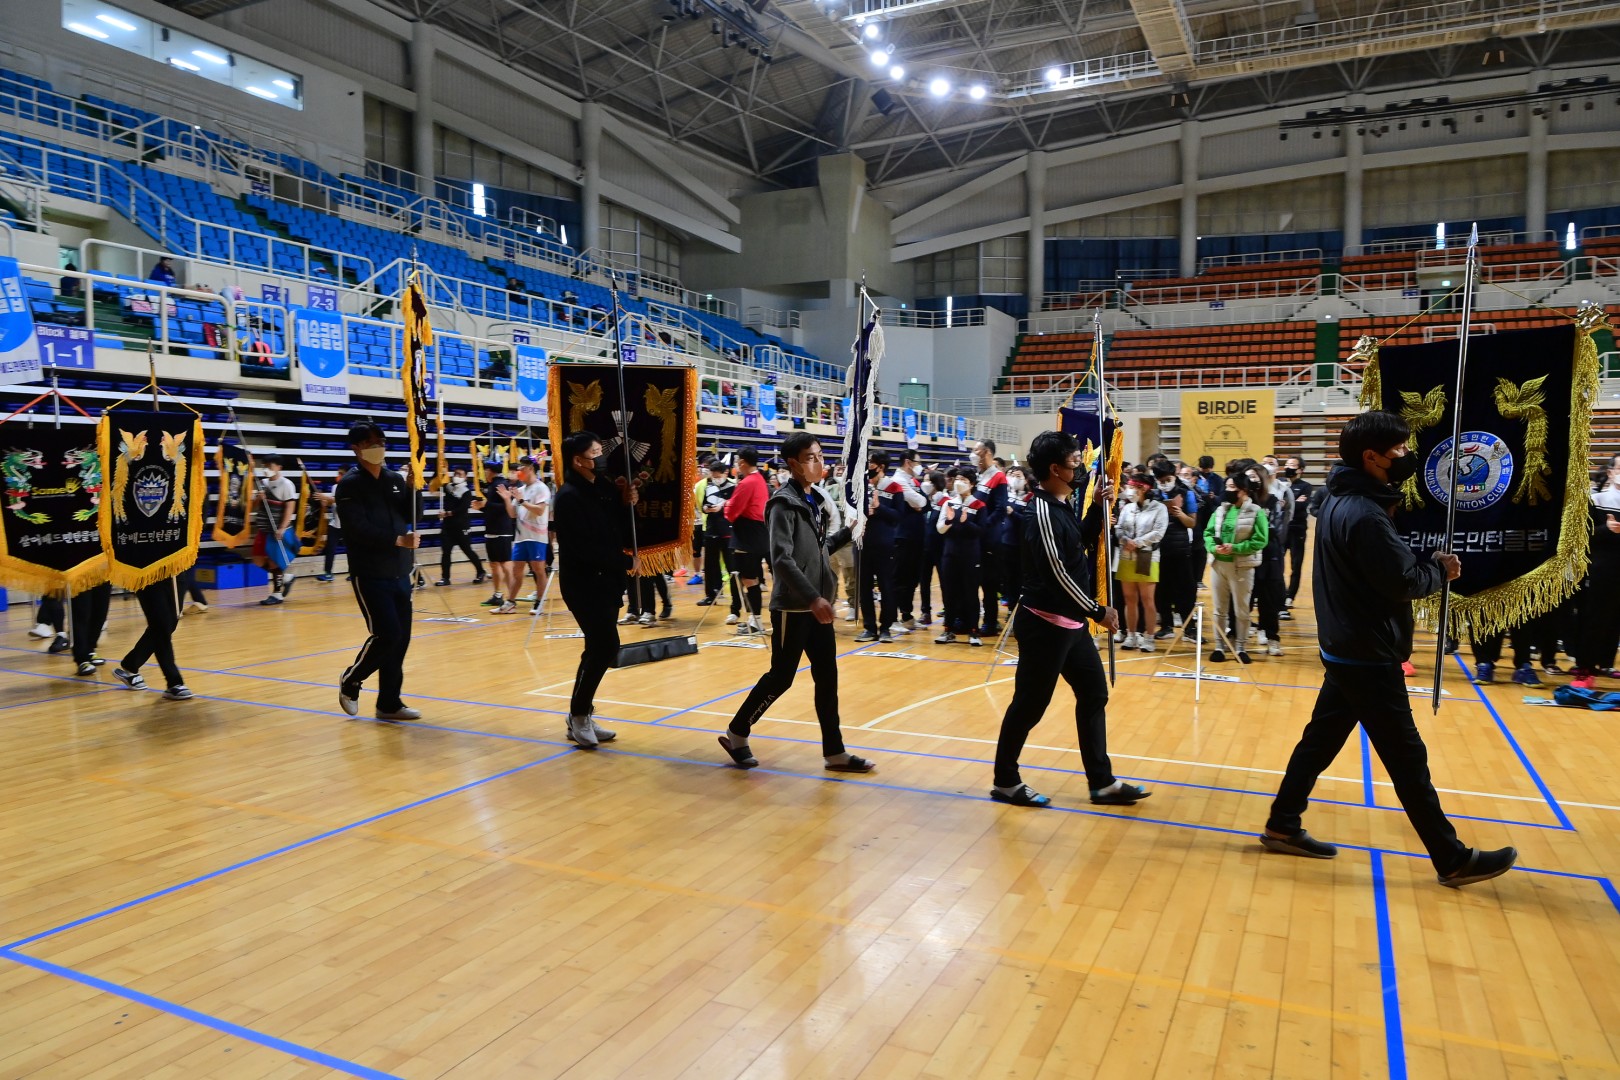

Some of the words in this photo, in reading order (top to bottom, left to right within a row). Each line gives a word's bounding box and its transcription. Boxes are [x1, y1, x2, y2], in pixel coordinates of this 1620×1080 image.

[311, 295, 335, 311] 2-3
[37, 326, 65, 338] Block
[43, 342, 84, 365] 1-1
[1198, 400, 1256, 415] BIRDIE
[1426, 469, 1437, 489] NURI
[1433, 487, 1486, 509] BADINTON
[1487, 482, 1505, 501] CLUB
[636, 500, 673, 518] 턴클럽
[117, 528, 181, 545] 솔배드민턴클럽
